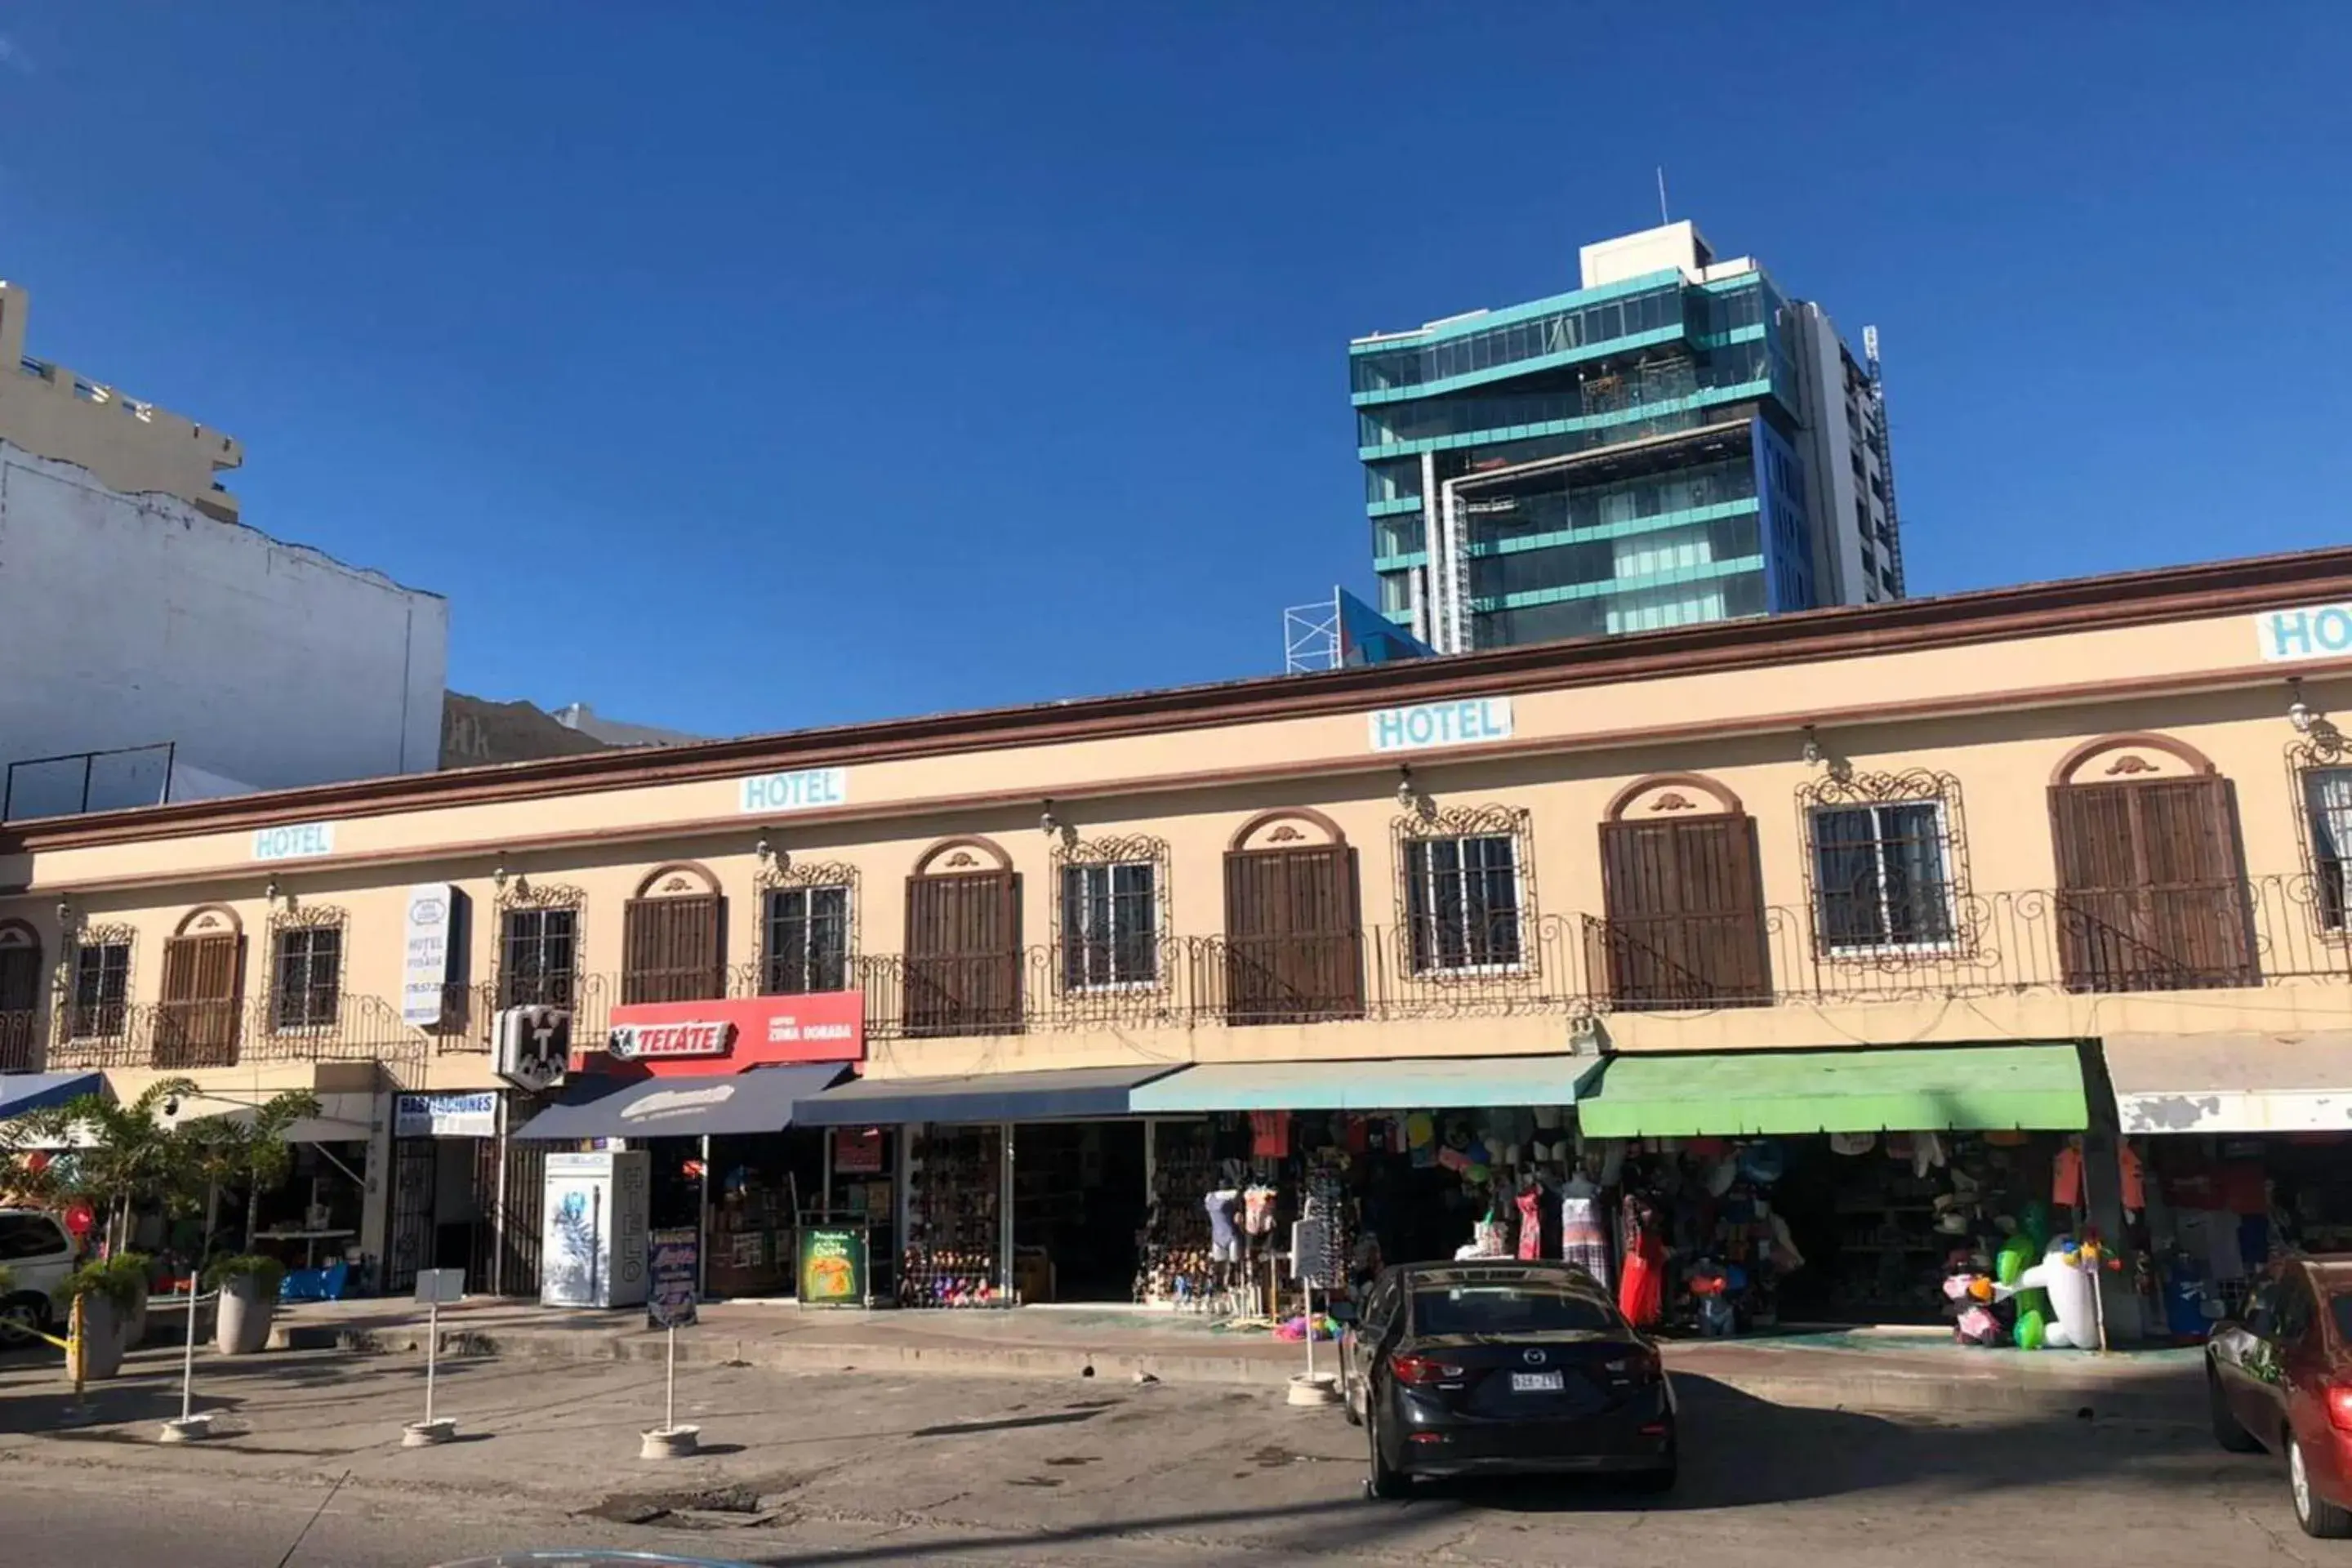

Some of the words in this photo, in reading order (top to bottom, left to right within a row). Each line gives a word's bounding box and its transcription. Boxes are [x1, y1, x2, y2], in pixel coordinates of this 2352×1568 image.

[1378, 701, 1501, 747] HOTEL
[746, 771, 837, 808] HOTEL
[256, 825, 327, 858] HOTEL
[409, 938, 443, 952] HOTEL
[638, 1021, 717, 1052] TECATE
